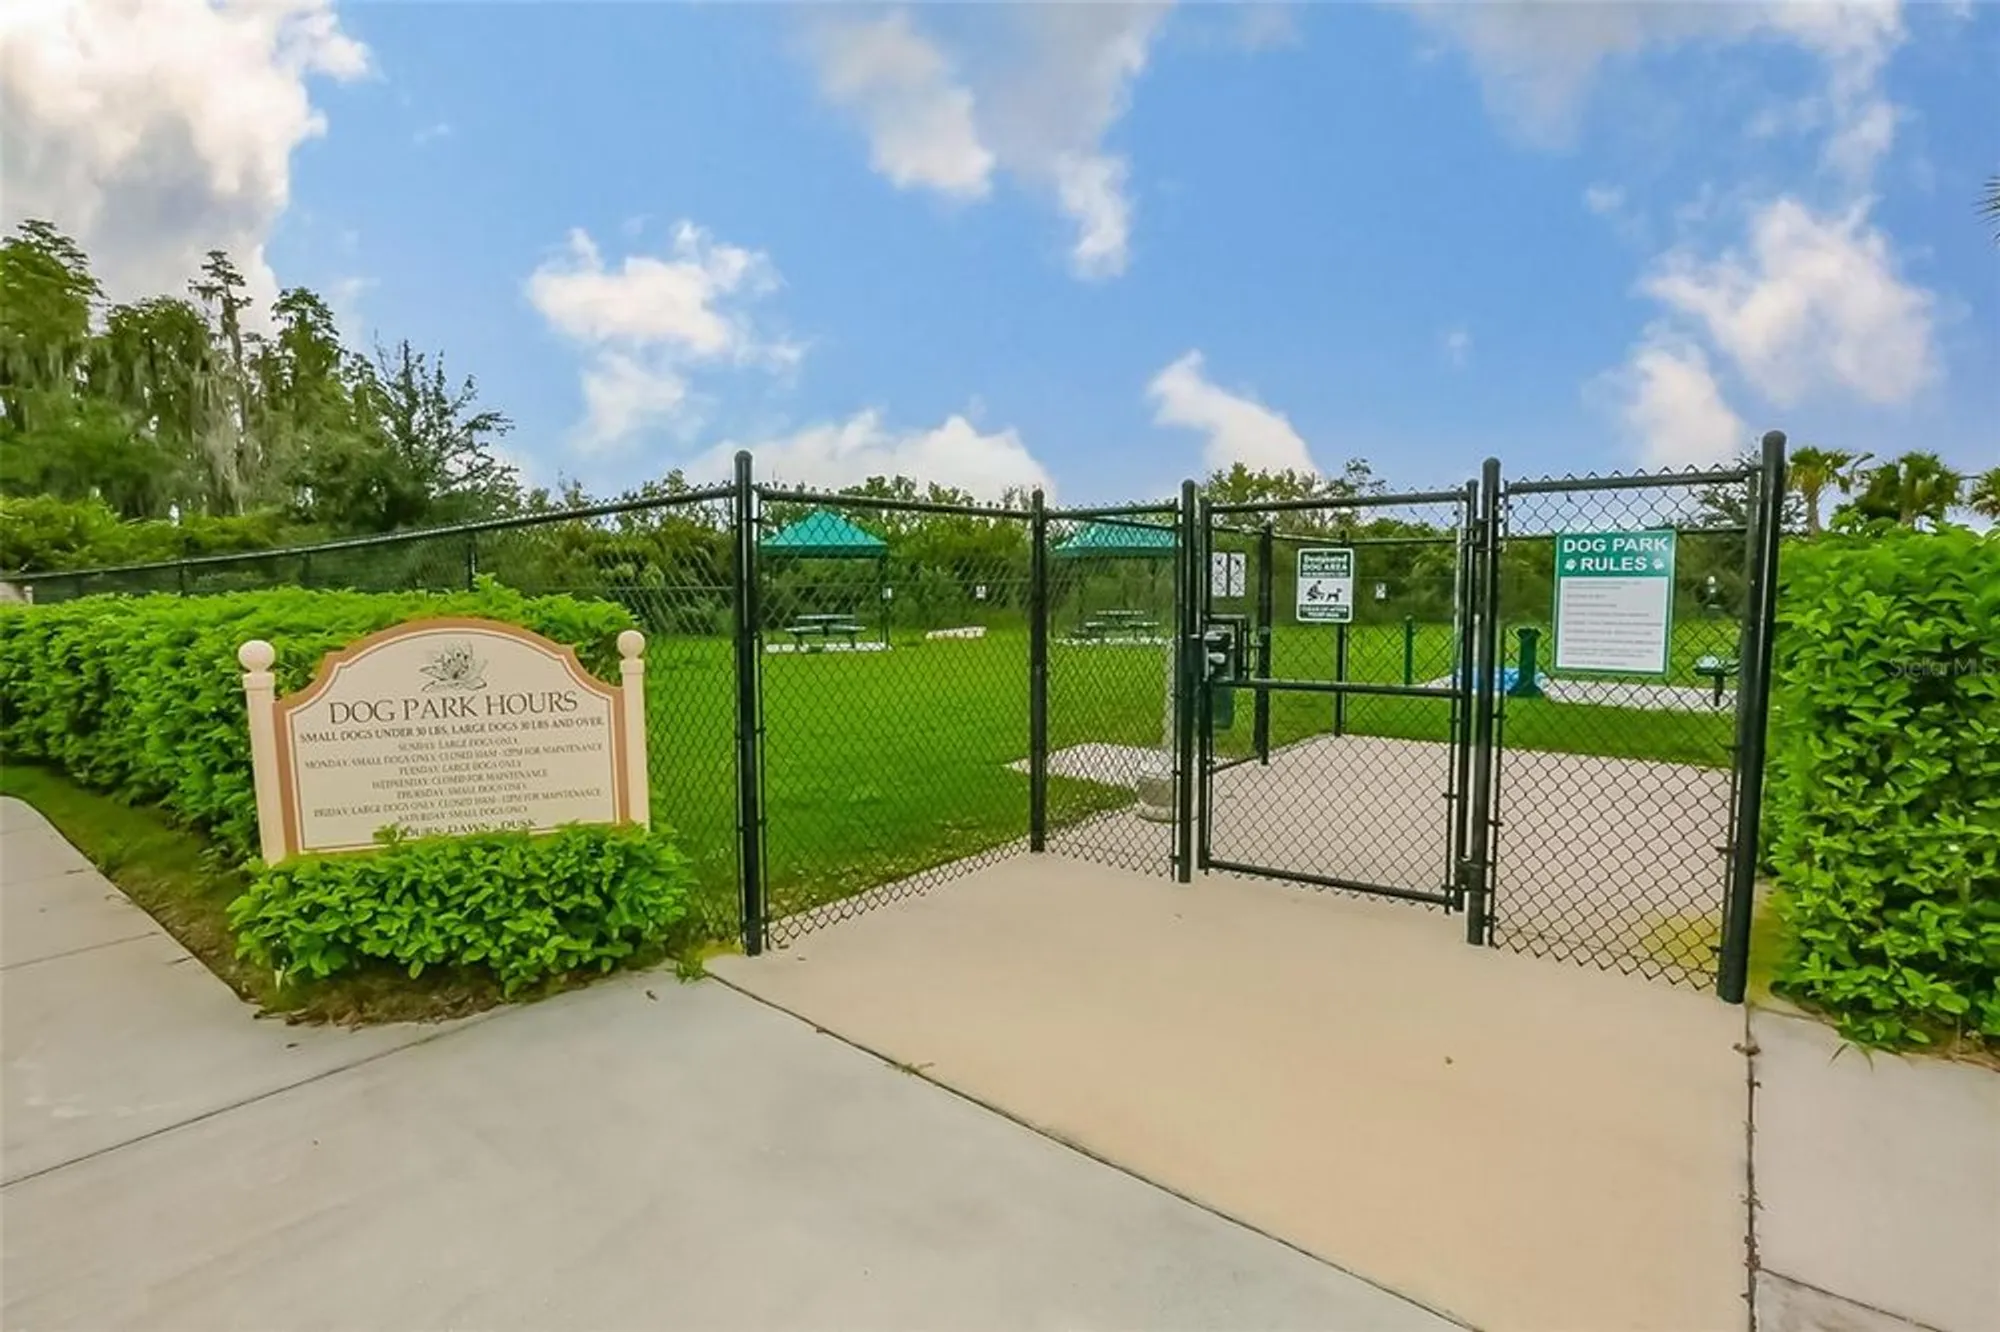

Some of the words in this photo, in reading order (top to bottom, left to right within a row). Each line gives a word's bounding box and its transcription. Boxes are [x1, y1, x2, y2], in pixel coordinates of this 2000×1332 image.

[1563, 537, 1606, 553] DOG
[1612, 537, 1669, 552] PARK
[1580, 556, 1647, 571] RULES
[329, 700, 395, 724] DOG
[402, 695, 478, 720] PARK
[486, 691, 577, 715] HOURS
[301, 731, 338, 743] SMALL
[341, 729, 373, 741] DOGS
[376, 727, 413, 739] UNDER
[416, 727, 426, 736] 30
[452, 723, 486, 734] LARGE
[488, 721, 518, 732] DOGS
[532, 720, 549, 730] LBS
[552, 718, 573, 729] AND
[439, 739, 466, 749] LARGE
[469, 737, 494, 747] DOGS
[352, 757, 382, 767] SMALL
[384, 755, 410, 765] DOGS
[439, 751, 473, 761] CLOSED
[524, 746, 540, 756] FOR
[543, 743, 602, 754] MAINTENANCE
[442, 764, 470, 774] LARGE
[472, 762, 497, 772] DOGS
[432, 775, 466, 785] CLOSED
[467, 773, 484, 783] FOR
[486, 769, 548, 781] MAINTENANCE
[448, 786, 476, 796] SMALL
[478, 784, 502, 794] DOGS
[352, 804, 381, 814] LARGE
[384, 802, 409, 812] DOGS
[438, 798, 473, 808] CLOSED
[524, 792, 540, 802] FOR
[541, 788, 600, 799] MAINTENANCE
[449, 809, 477, 819] SMALL
[479, 807, 504, 817] DOGS
[448, 822, 490, 833] DAWN
[501, 818, 537, 830] DUSK
